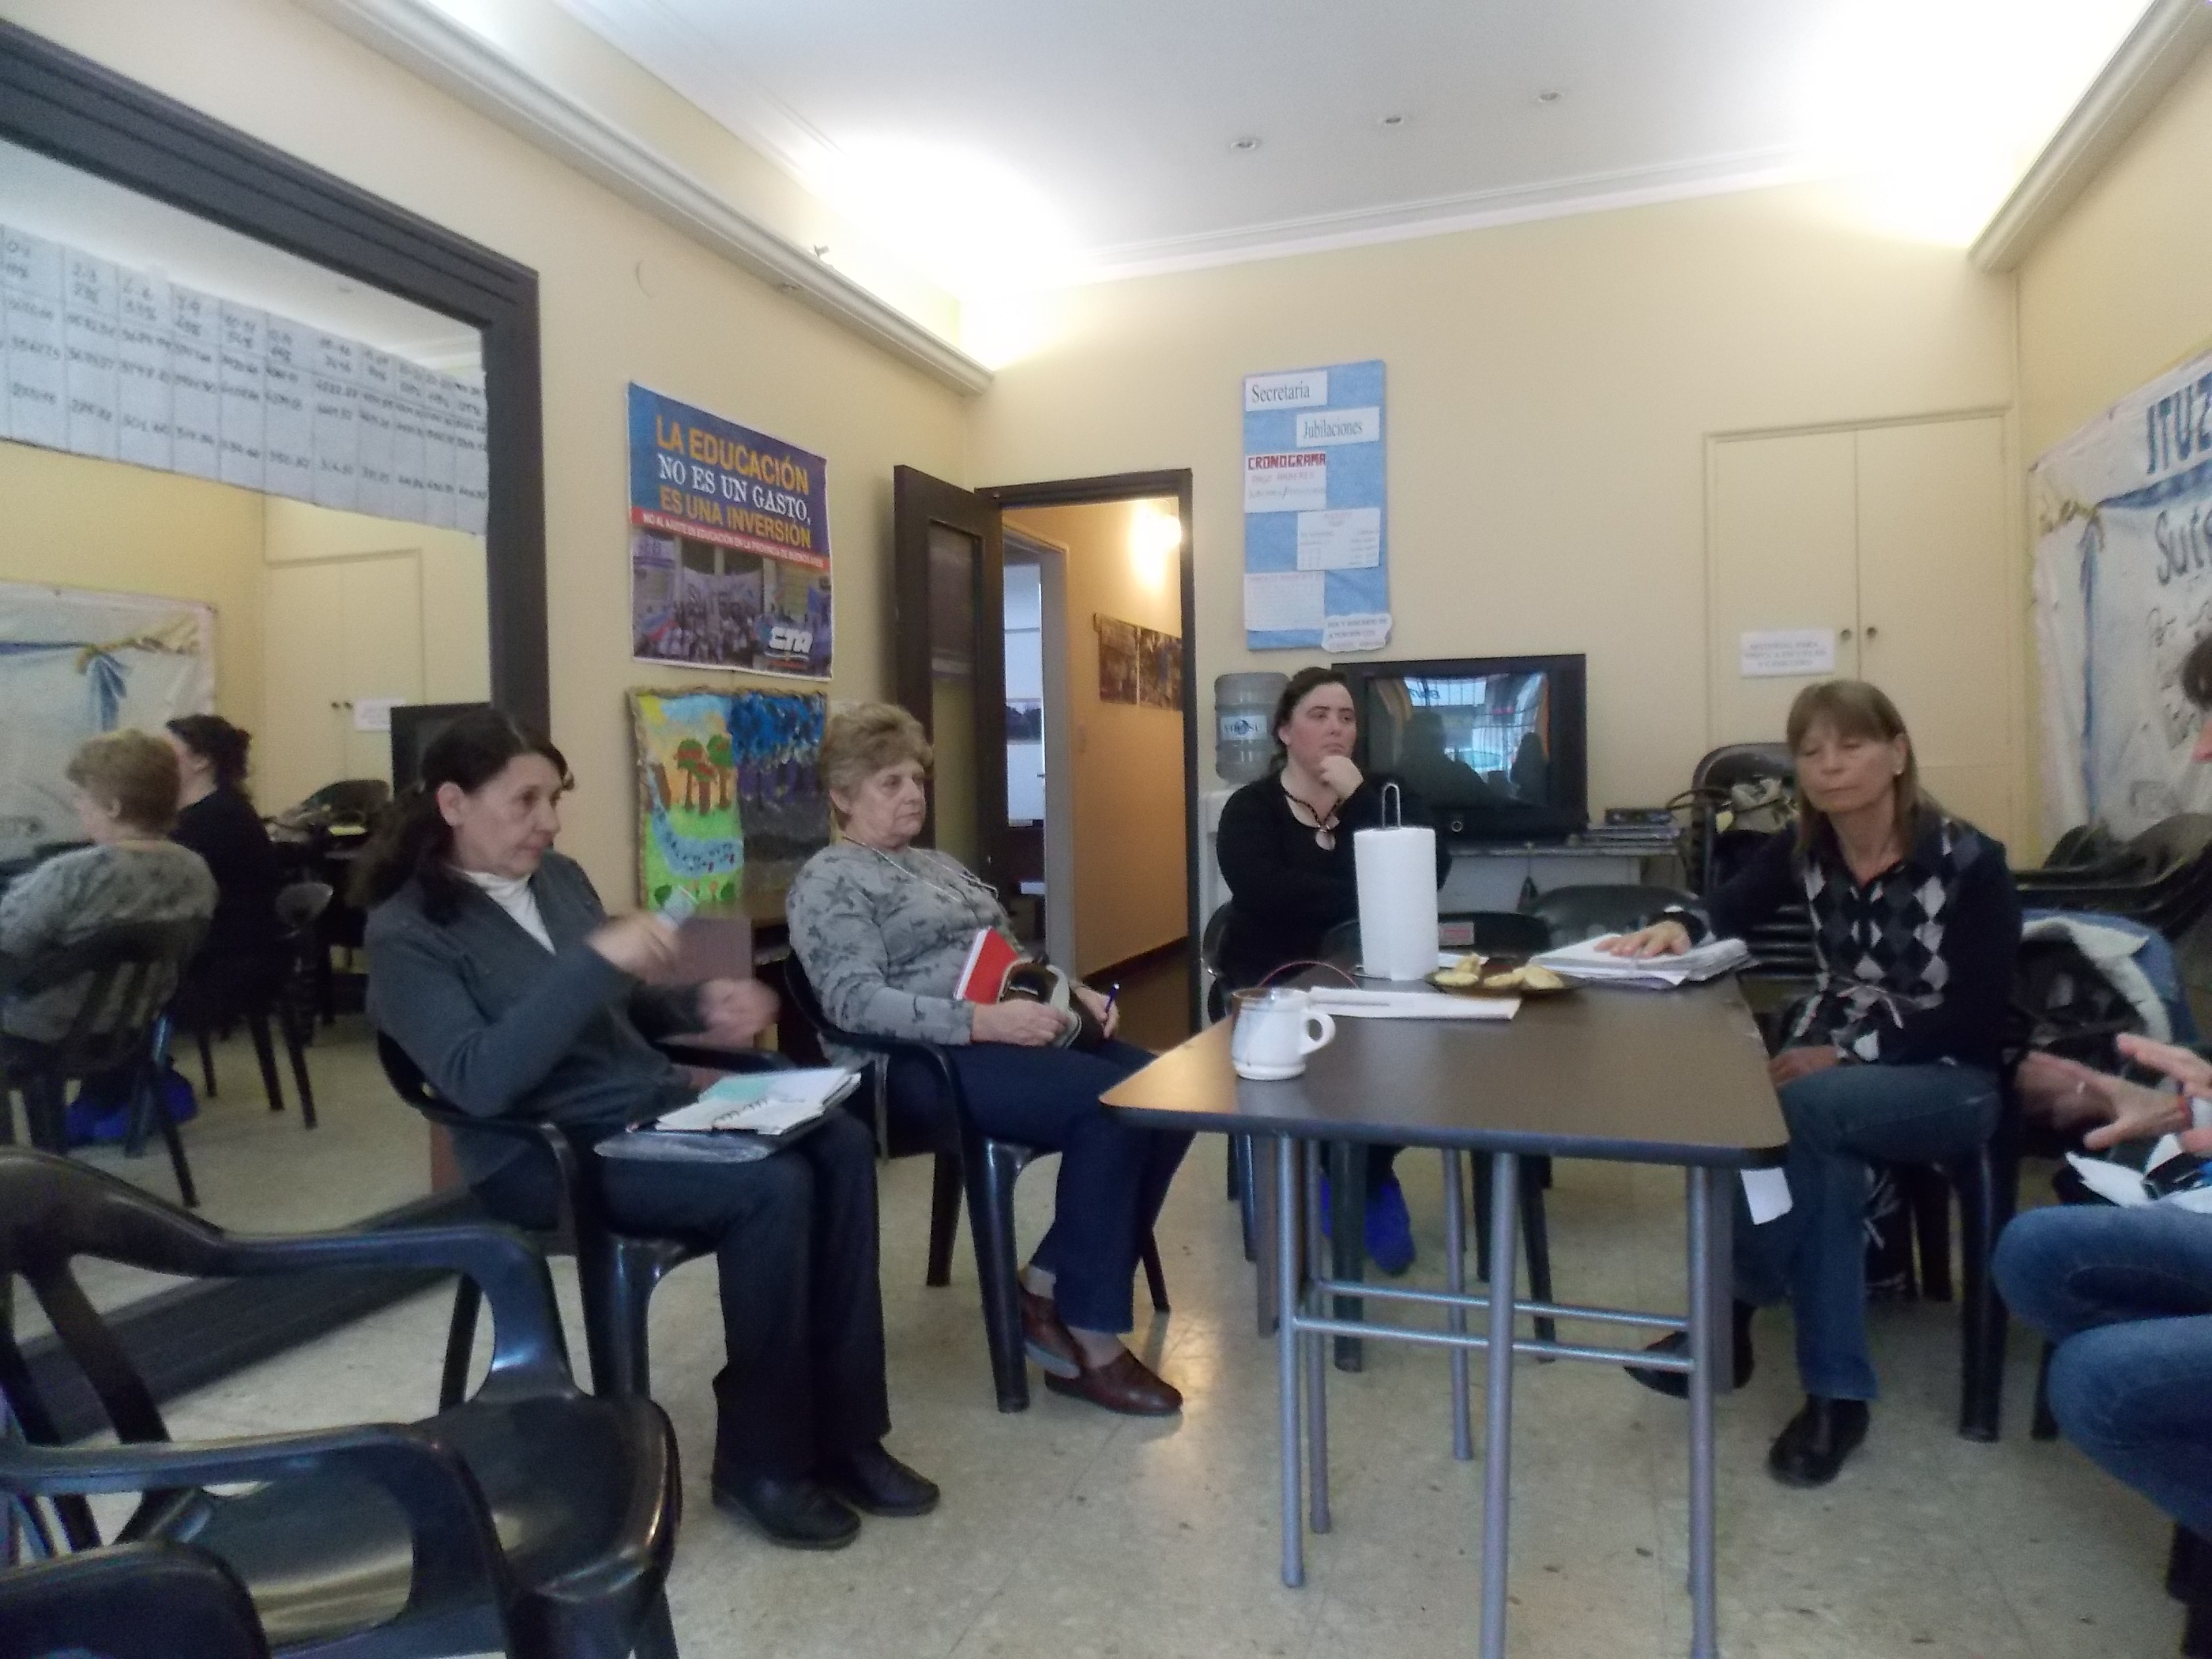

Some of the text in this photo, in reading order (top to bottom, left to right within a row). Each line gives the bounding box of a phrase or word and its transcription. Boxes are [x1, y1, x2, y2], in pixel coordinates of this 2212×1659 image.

[1303, 418, 1363, 440] Jubilaciones
[656, 414, 809, 495] LA EDUCACIÓN
[1248, 453, 1326, 470] CRONOGRAMA
[657, 453, 811, 525] NO ES UN GASTO,
[660, 485, 683, 515] ES
[686, 494, 723, 525] UNA
